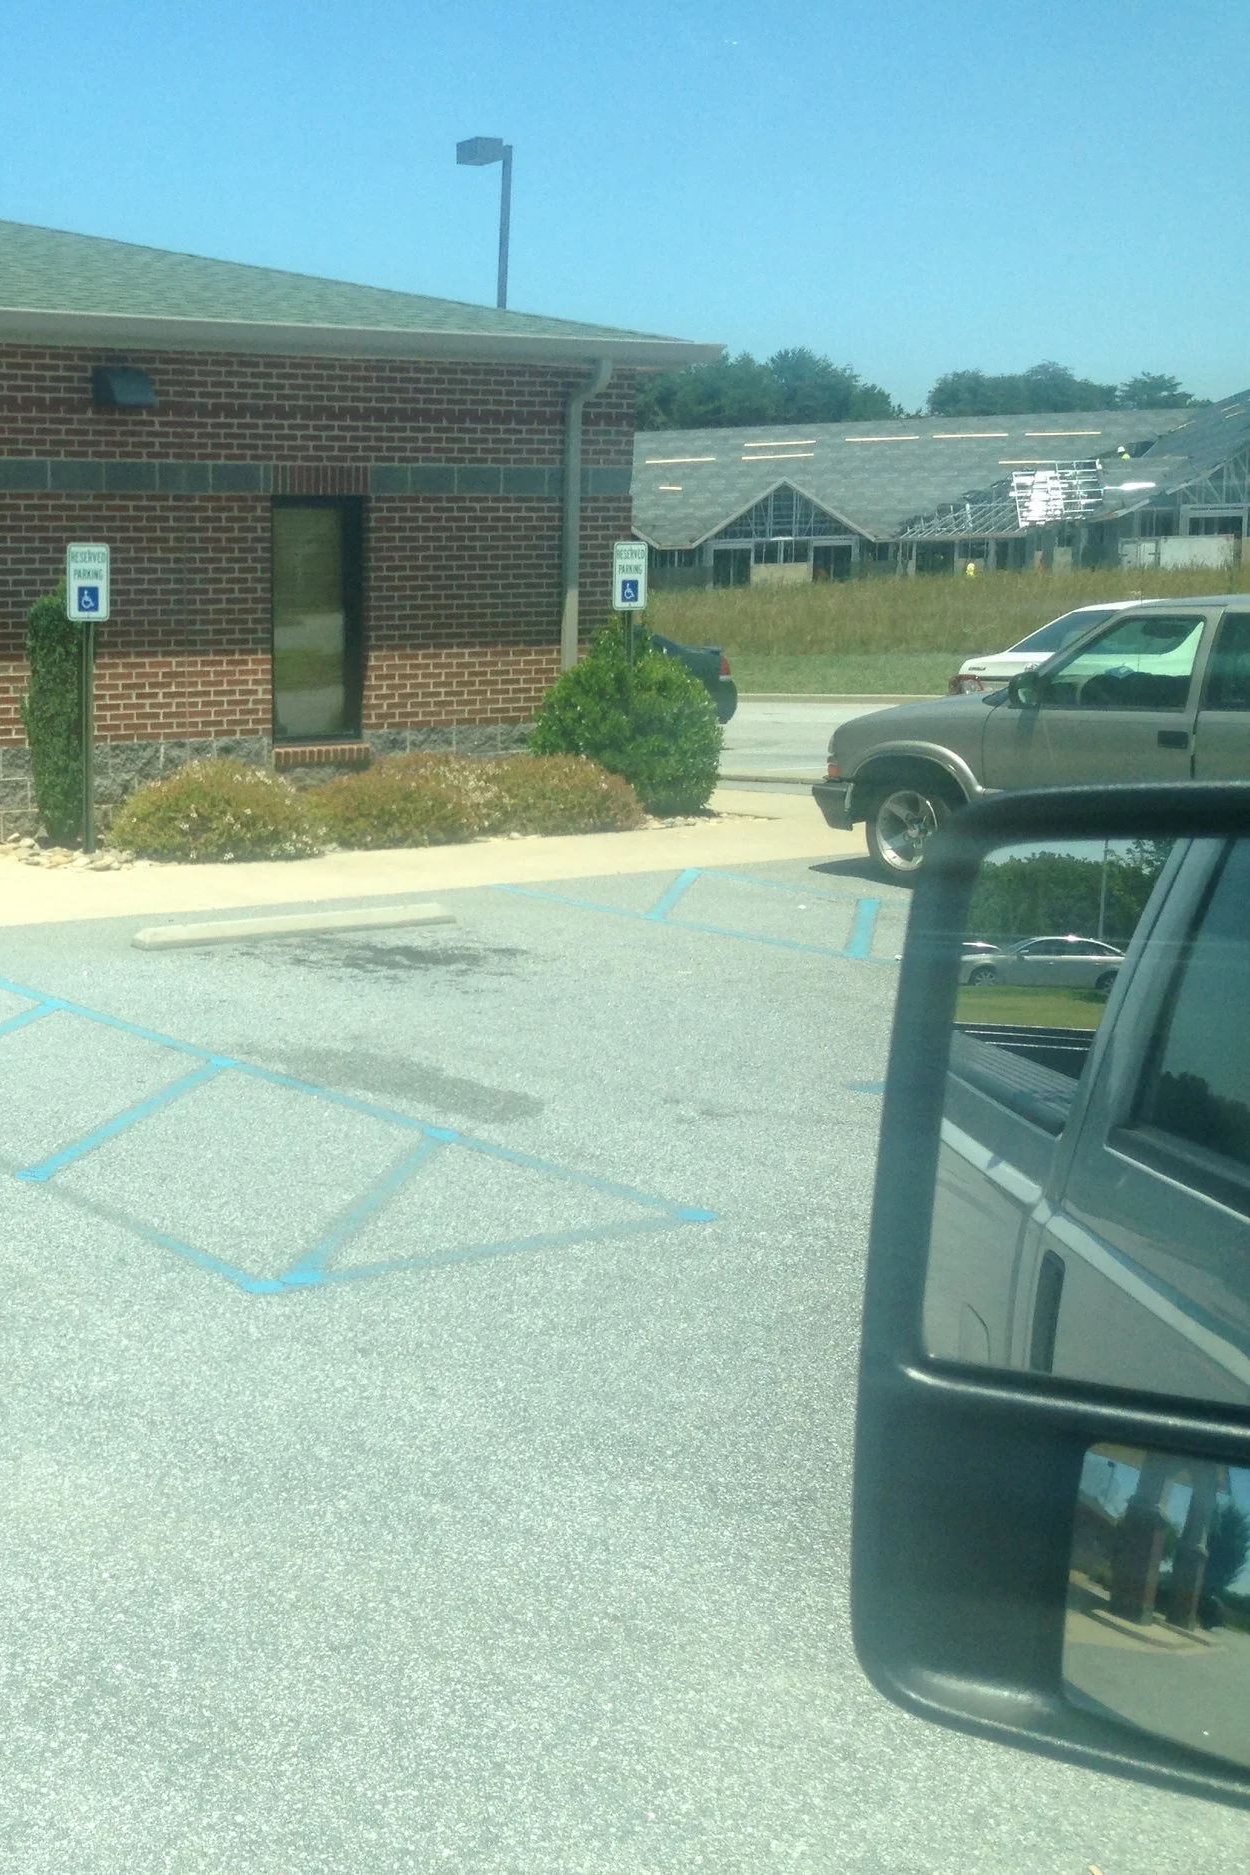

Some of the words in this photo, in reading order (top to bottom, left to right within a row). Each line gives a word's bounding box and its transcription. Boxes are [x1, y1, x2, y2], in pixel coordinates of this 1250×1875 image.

[71, 551, 106, 564] RESERVED
[616, 549, 646, 560] RESERVED
[73, 568, 104, 581] PARKING
[618, 564, 643, 575] PARKING
